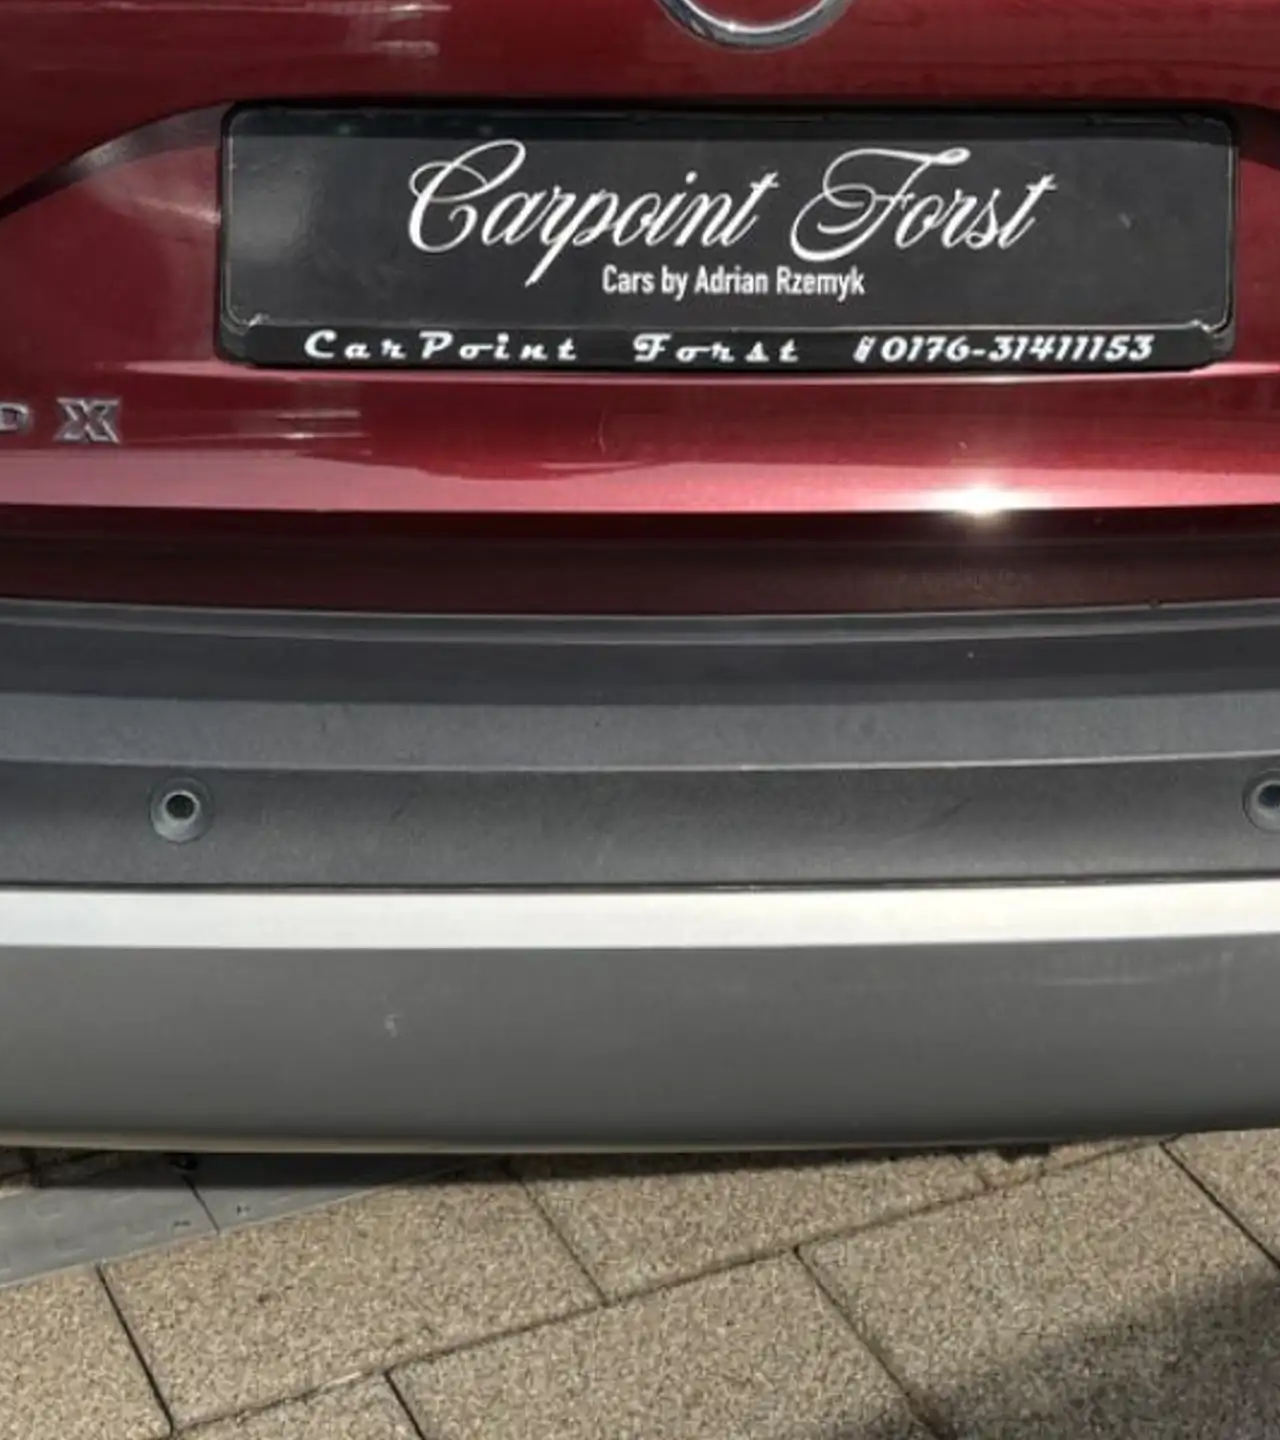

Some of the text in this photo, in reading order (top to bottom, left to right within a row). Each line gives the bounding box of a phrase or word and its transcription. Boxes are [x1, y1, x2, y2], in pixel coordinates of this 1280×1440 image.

[409, 138, 1058, 287] Carpoint Forst
[601, 264, 866, 302] Cars by Adrian Rzemyk
[304, 329, 1154, 363] CarPoint Forst 0176-31411153
[54, 397, 121, 444] X
